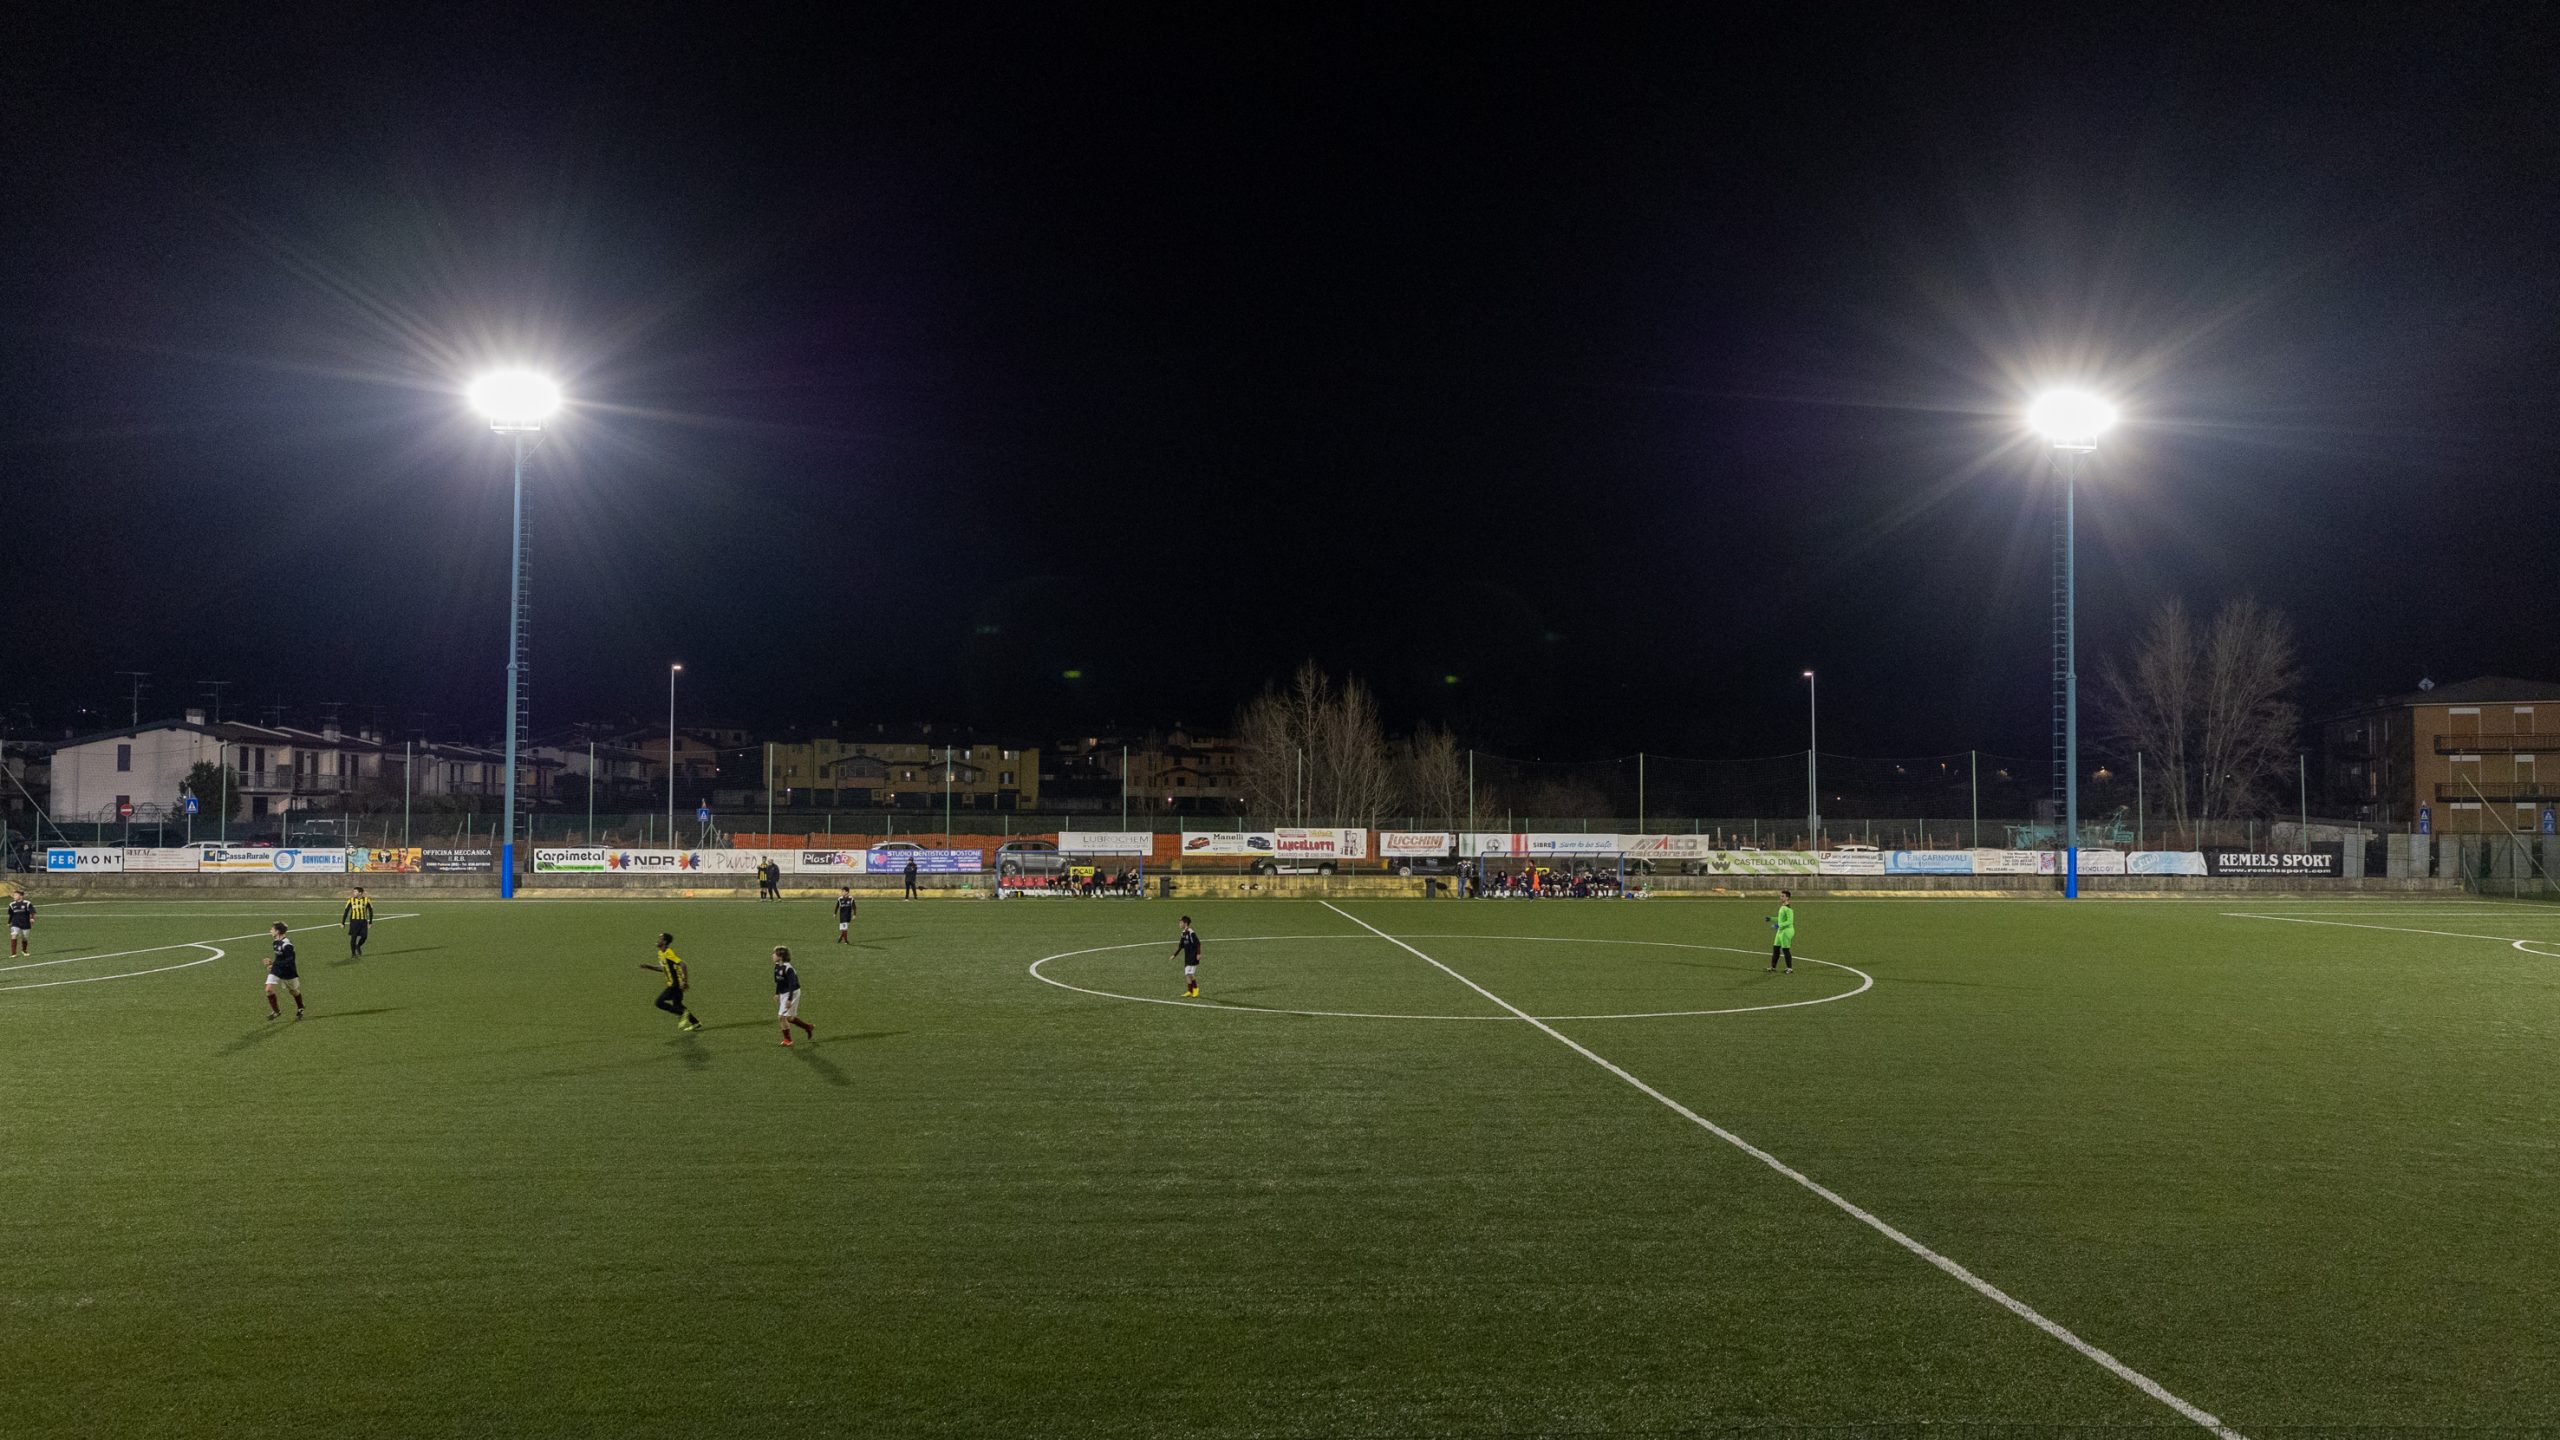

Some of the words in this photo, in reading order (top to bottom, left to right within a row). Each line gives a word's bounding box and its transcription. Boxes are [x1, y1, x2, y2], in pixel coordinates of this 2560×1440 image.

[1213, 833, 1244, 841] Manelli
[1387, 833, 1444, 849] LUCCHINI
[1277, 839, 1335, 851] LANCELLOTTI
[50, 855, 122, 865] FERMONT
[246, 852, 270, 860] Rurale
[536, 850, 605, 863] Carpimetal
[634, 856, 675, 866] NDR
[716, 852, 758, 870] Punto
[1921, 854, 1967, 862] CARNOVALI
[2219, 853, 2279, 866] REMELS
[2282, 854, 2333, 867] SPORT
[1734, 858, 1776, 866] CASTELLO
[1778, 858, 1787, 866] DI
[1788, 858, 1816, 866] VALLIO
